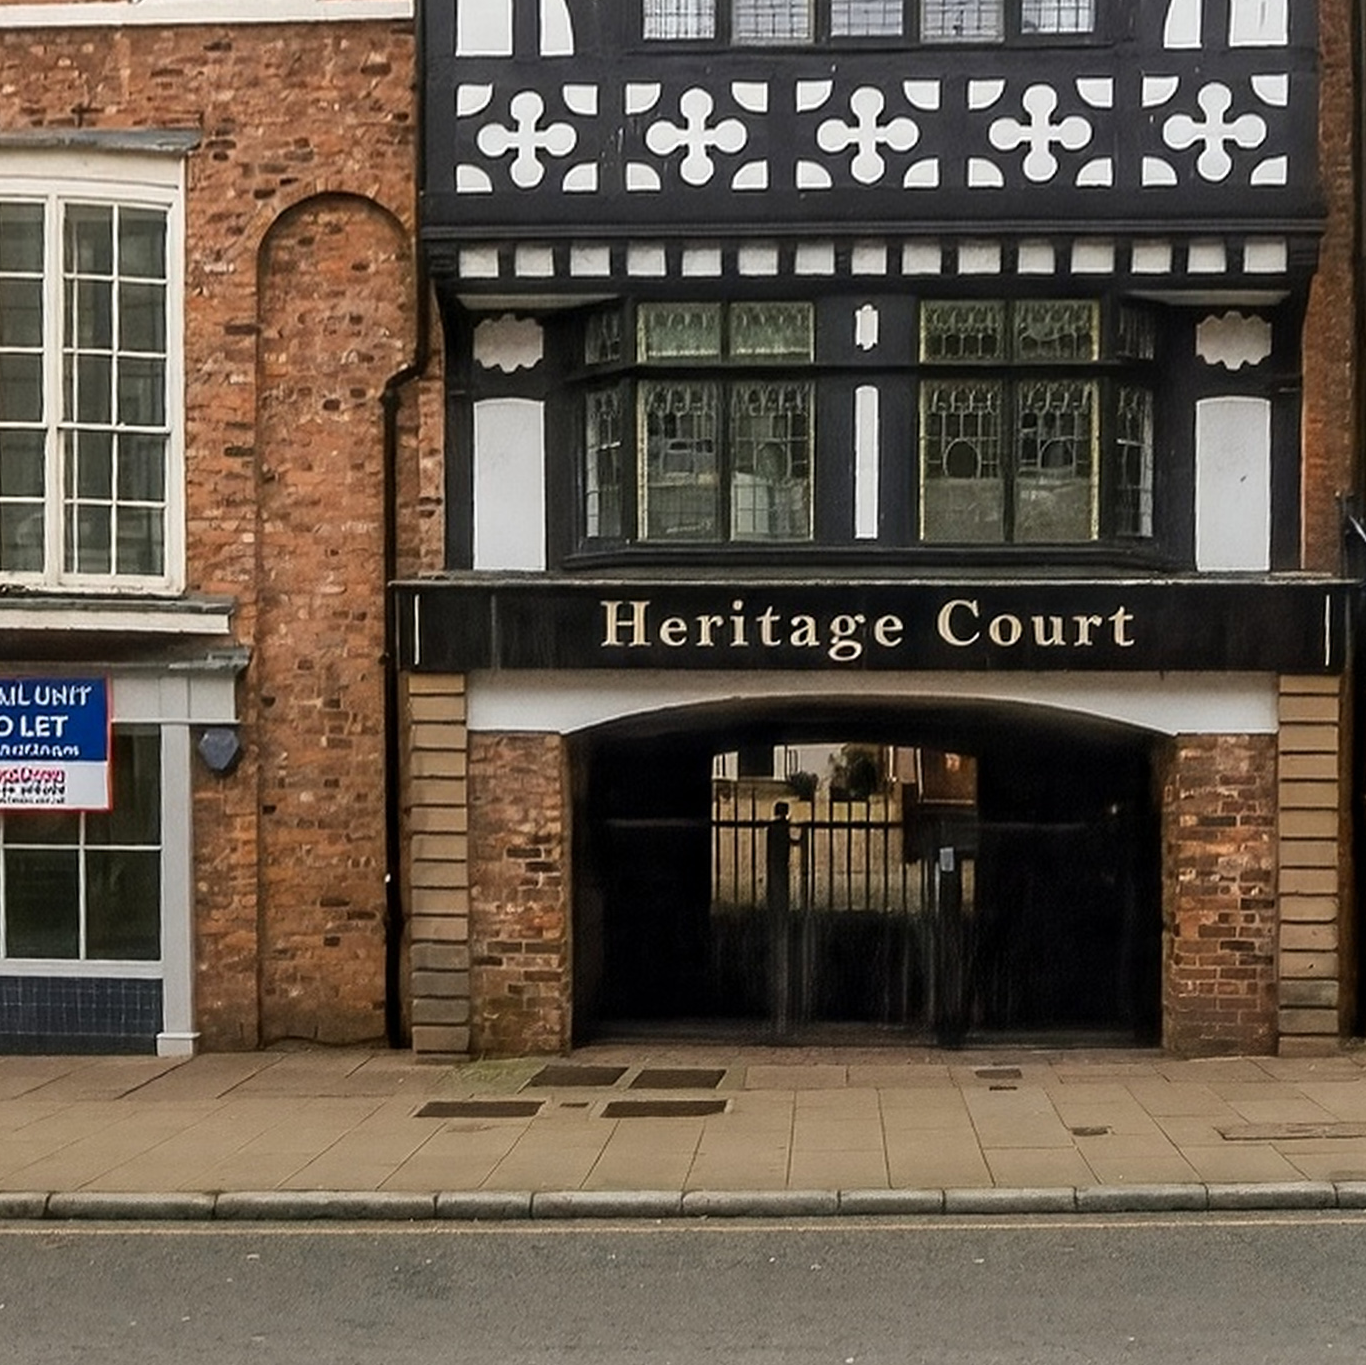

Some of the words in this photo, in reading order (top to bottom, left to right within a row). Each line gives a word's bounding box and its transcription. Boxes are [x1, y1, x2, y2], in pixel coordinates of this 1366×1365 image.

[599, 599, 905, 662] Heritage
[936, 599, 1136, 648] Court
[35, 684, 92, 707] UNIT
[20, 714, 69, 738] LET
